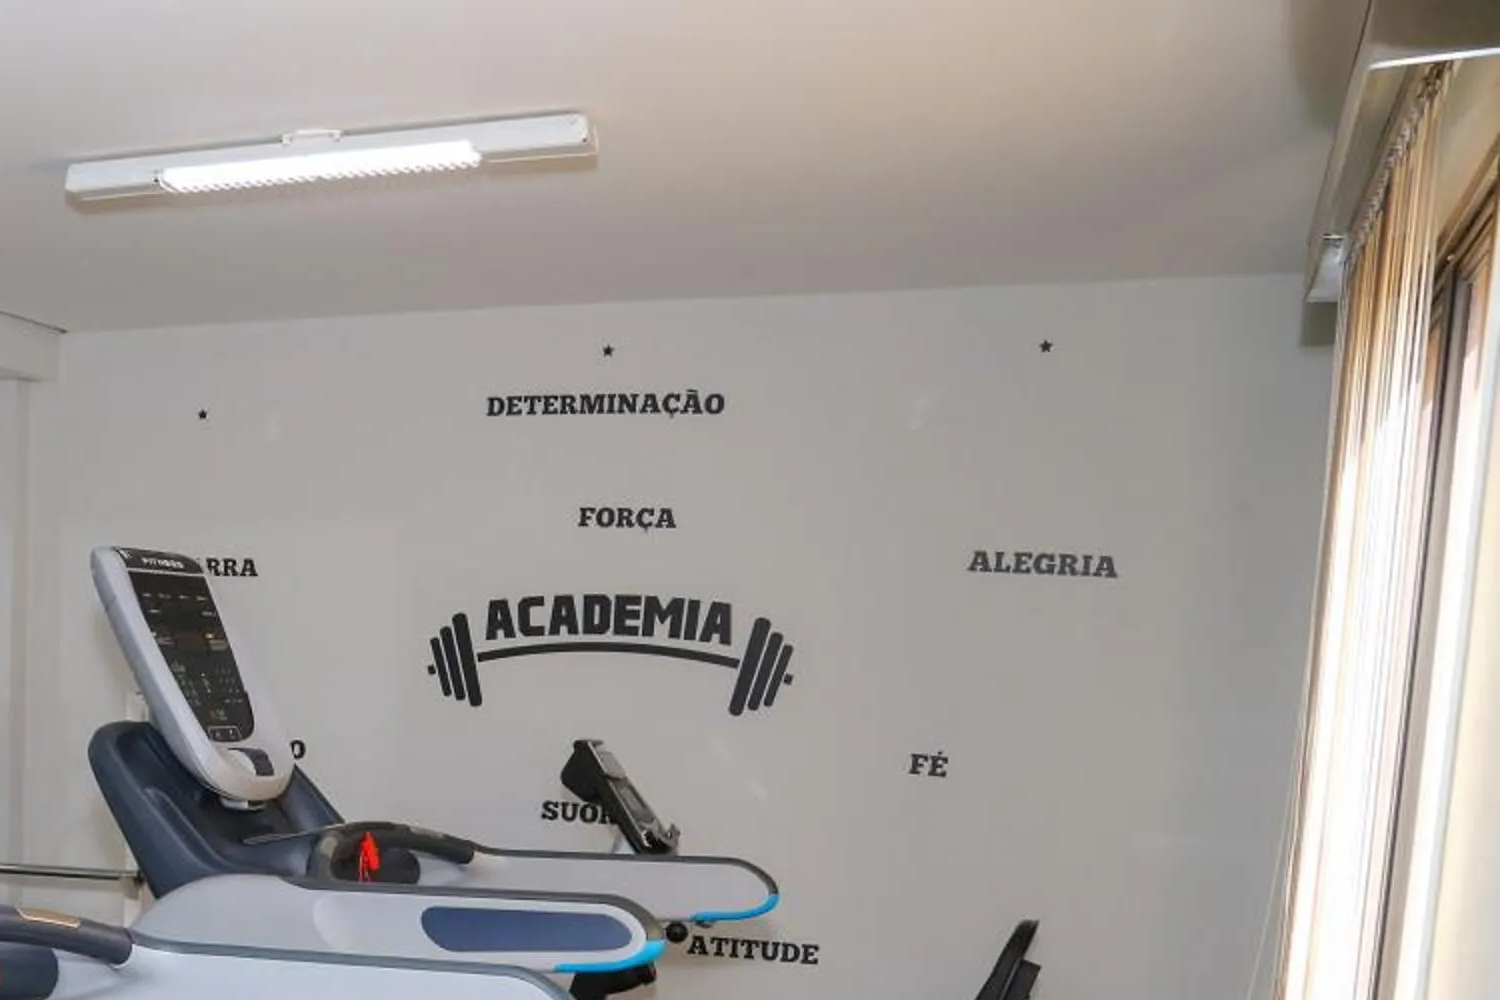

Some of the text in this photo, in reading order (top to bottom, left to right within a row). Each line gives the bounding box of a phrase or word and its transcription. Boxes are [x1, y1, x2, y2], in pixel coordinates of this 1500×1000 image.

[487, 388, 725, 418] DETERMINAÇÃO
[578, 507, 677, 532] FORÇA
[205, 557, 259, 577] RRA
[967, 550, 1118, 579] ALEGRIA
[485, 594, 731, 646] ACADEMIA
[908, 750, 949, 778] FÉ
[687, 935, 820, 965] ATITUDE
